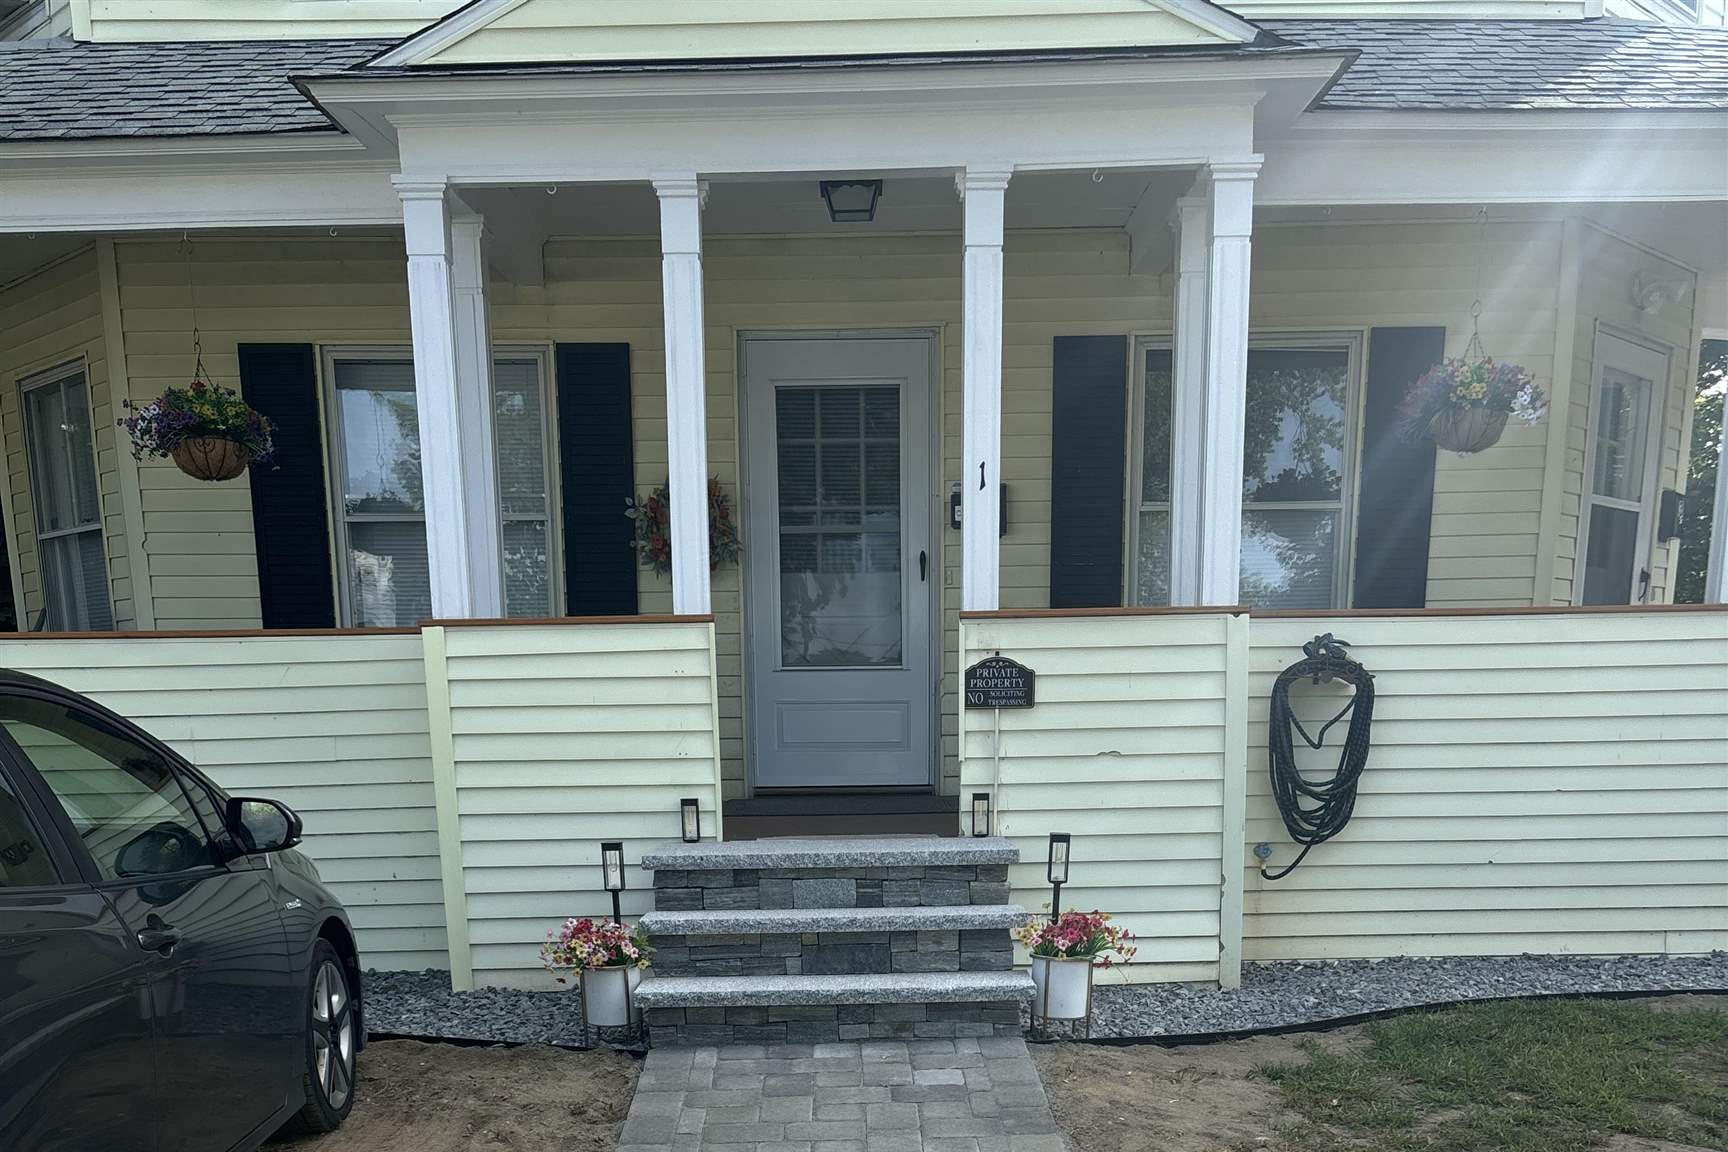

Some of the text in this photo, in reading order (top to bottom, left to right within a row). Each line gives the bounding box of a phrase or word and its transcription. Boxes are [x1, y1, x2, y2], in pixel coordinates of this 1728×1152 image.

[979, 461, 986, 491] 1
[976, 668, 1019, 678] PRIVATE
[970, 678, 1025, 688] PROPERTY
[968, 692, 984, 705] NO
